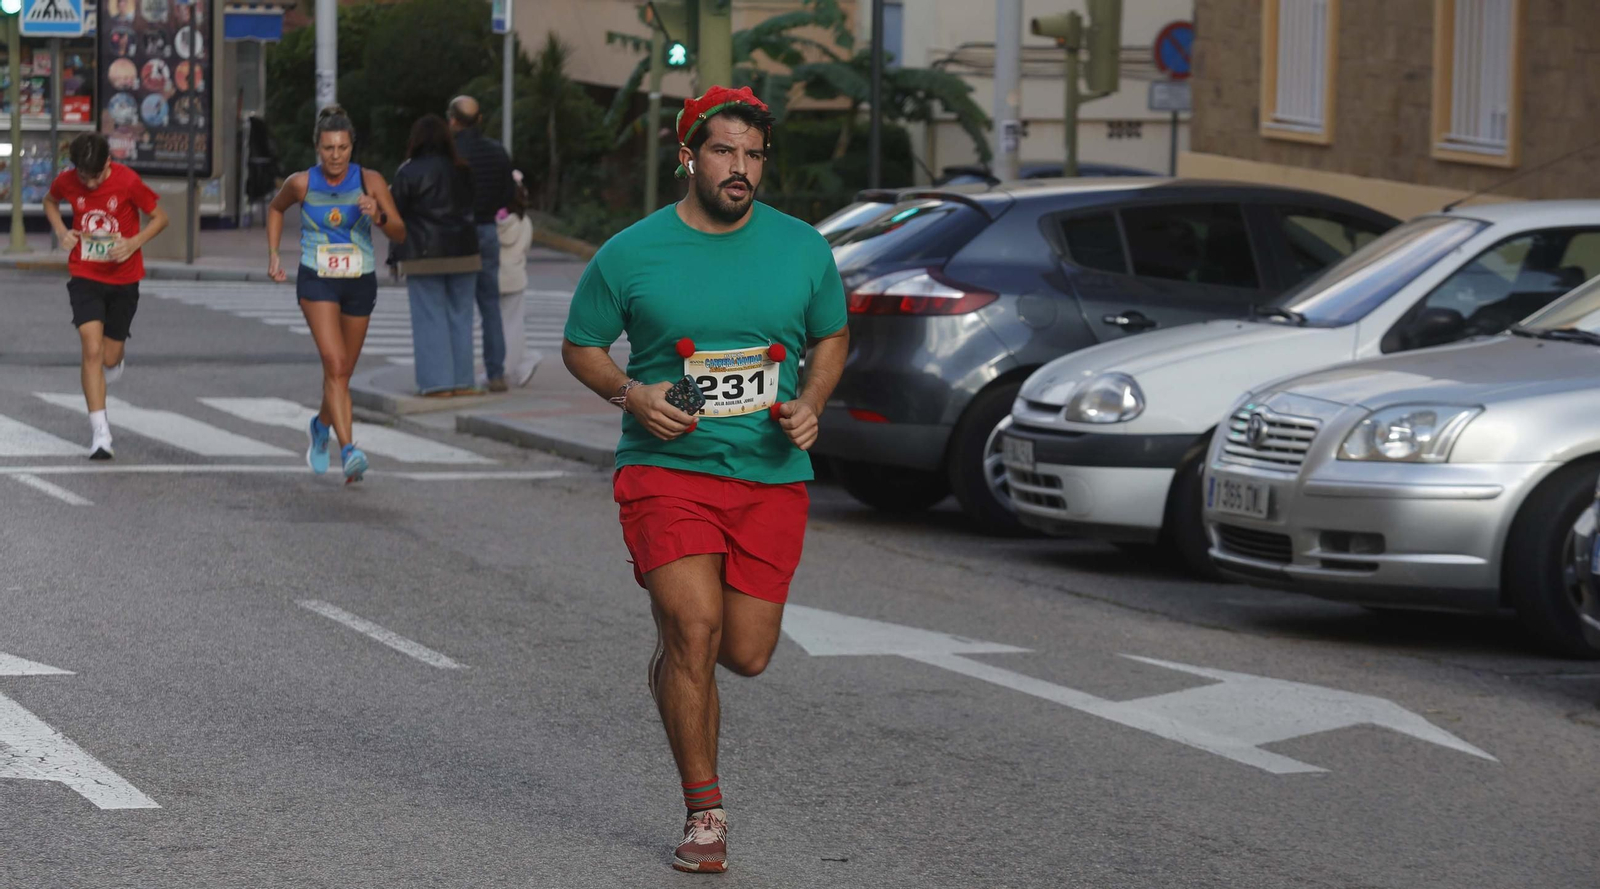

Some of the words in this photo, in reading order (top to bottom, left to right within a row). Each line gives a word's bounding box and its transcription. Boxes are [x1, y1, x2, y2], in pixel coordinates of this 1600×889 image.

[328, 255, 350, 270] 81
[705, 357, 734, 368] CARRERA
[737, 354, 763, 365] NAVIDAD
[696, 370, 764, 400] 231
